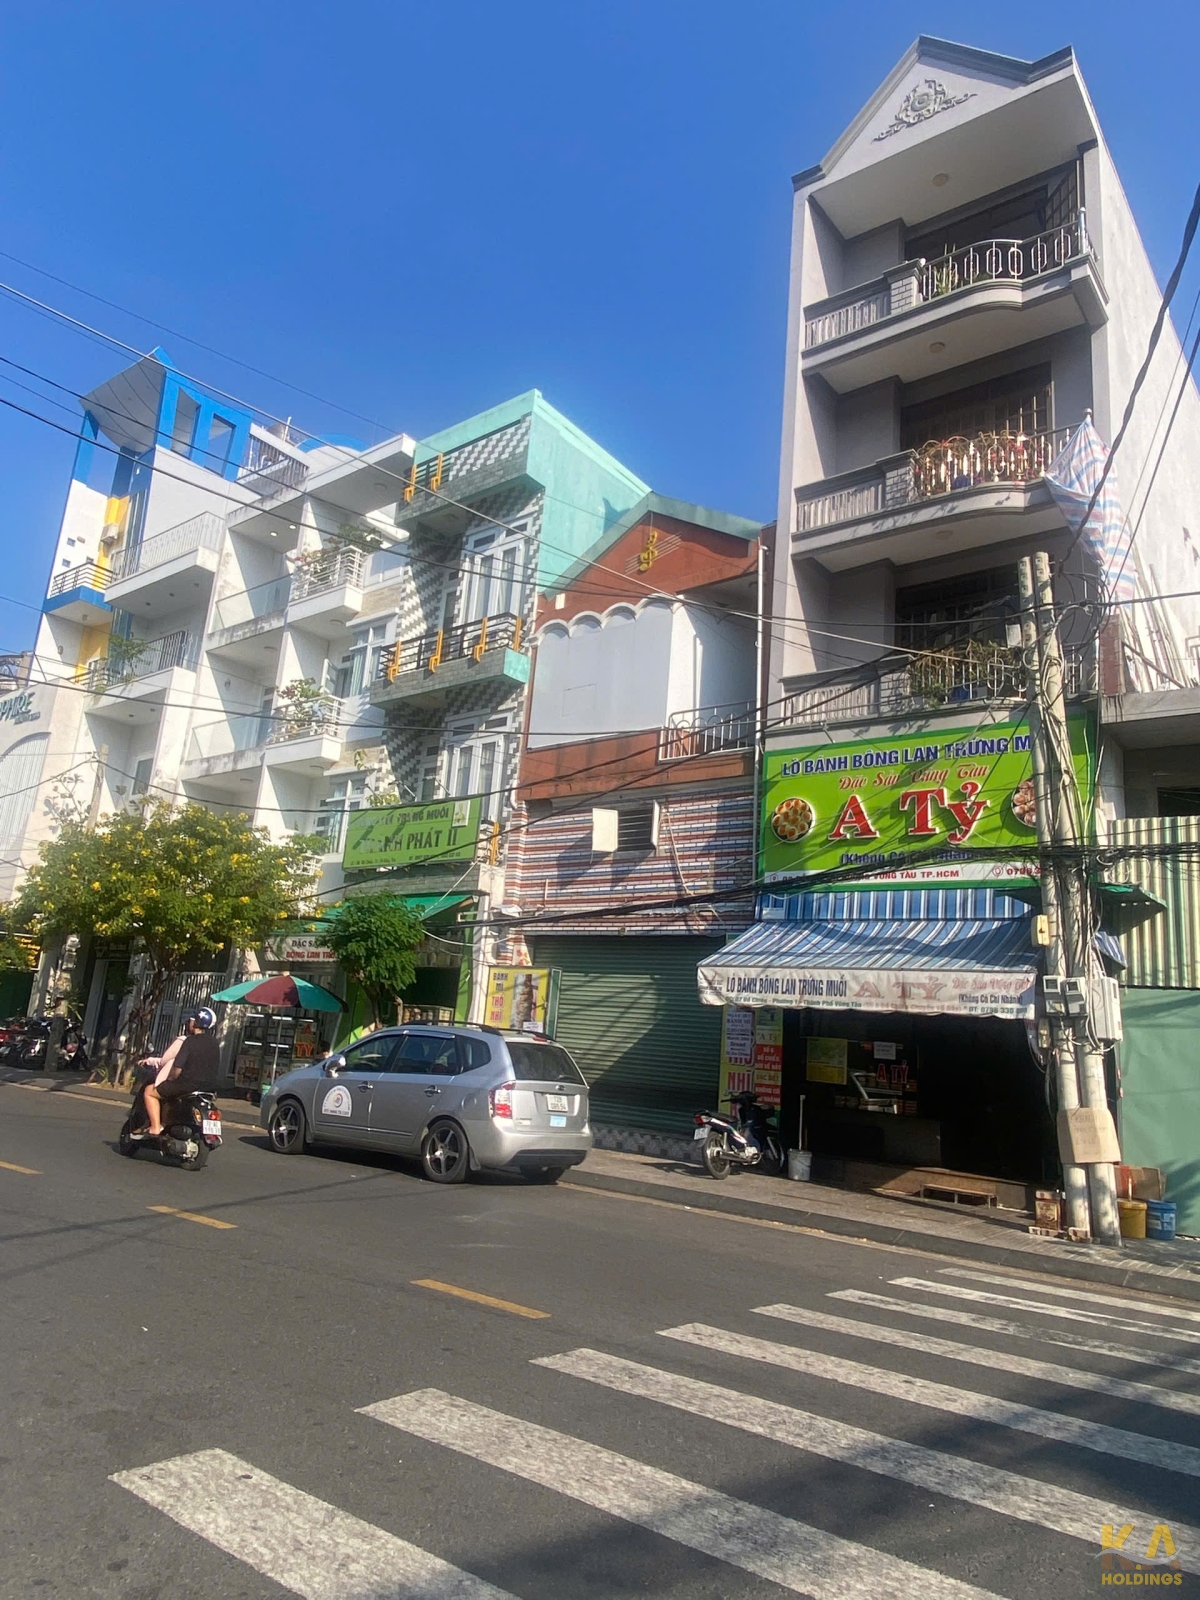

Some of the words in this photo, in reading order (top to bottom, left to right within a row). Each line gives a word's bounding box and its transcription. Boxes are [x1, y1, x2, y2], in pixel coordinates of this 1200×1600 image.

[782, 757, 801, 776] LÒ
[804, 754, 848, 774] BÁNH
[852, 749, 899, 769] BÔNG
[903, 744, 939, 764] LAN
[828, 793, 880, 840] A
[406, 827, 442, 850] PHÁT
[920, 869, 960, 879] TP.HCM
[726, 973, 736, 992] LÒ
[737, 974, 757, 993] BÁNH
[759, 974, 779, 994] BÔNG
[781, 978, 796, 995] LAN
[798, 976, 824, 996] TRỨNG
[826, 974, 847, 998] MUỐI
